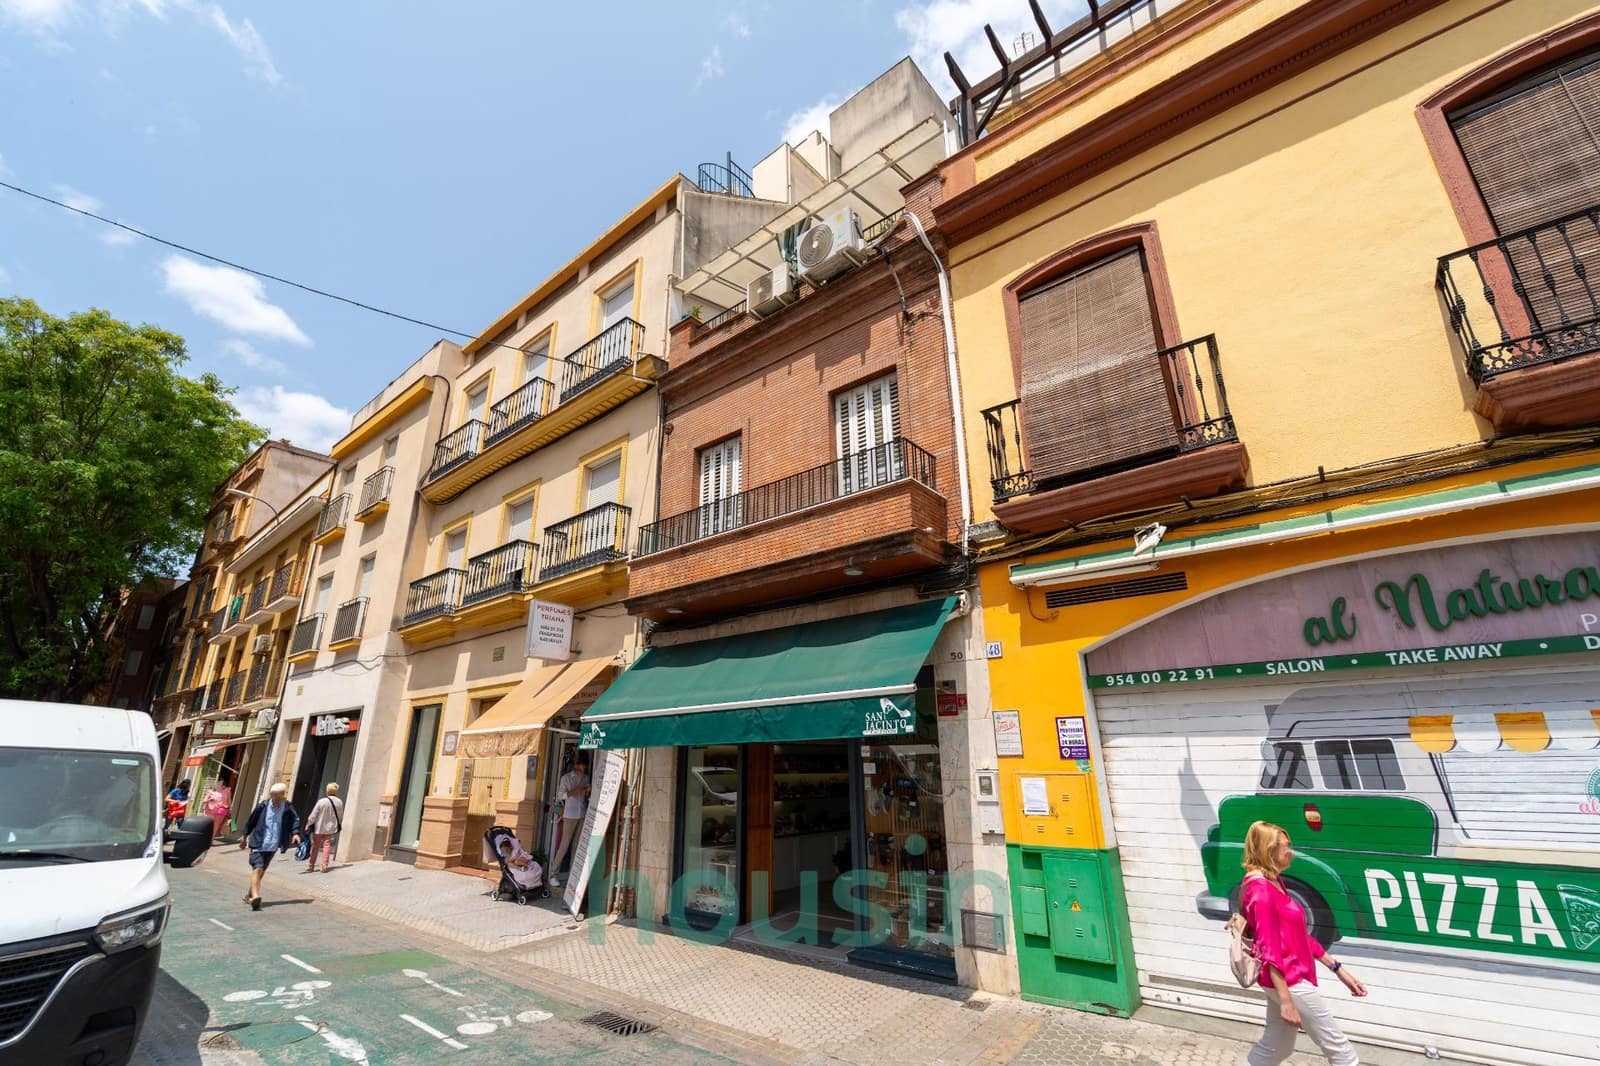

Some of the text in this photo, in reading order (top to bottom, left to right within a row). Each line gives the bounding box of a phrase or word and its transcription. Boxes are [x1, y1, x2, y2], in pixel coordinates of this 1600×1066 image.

[537, 604, 571, 616] PERFUMES
[542, 613, 566, 623] TRIANA
[1303, 597, 1357, 646] al
[951, 651, 963, 660] 50
[988, 643, 1001, 656] 48
[1106, 644, 1504, 687] 954 00 22 91 SALON TAKE AWAY
[865, 711, 887, 722] SAN
[1364, 868, 1568, 949] PIZZA
